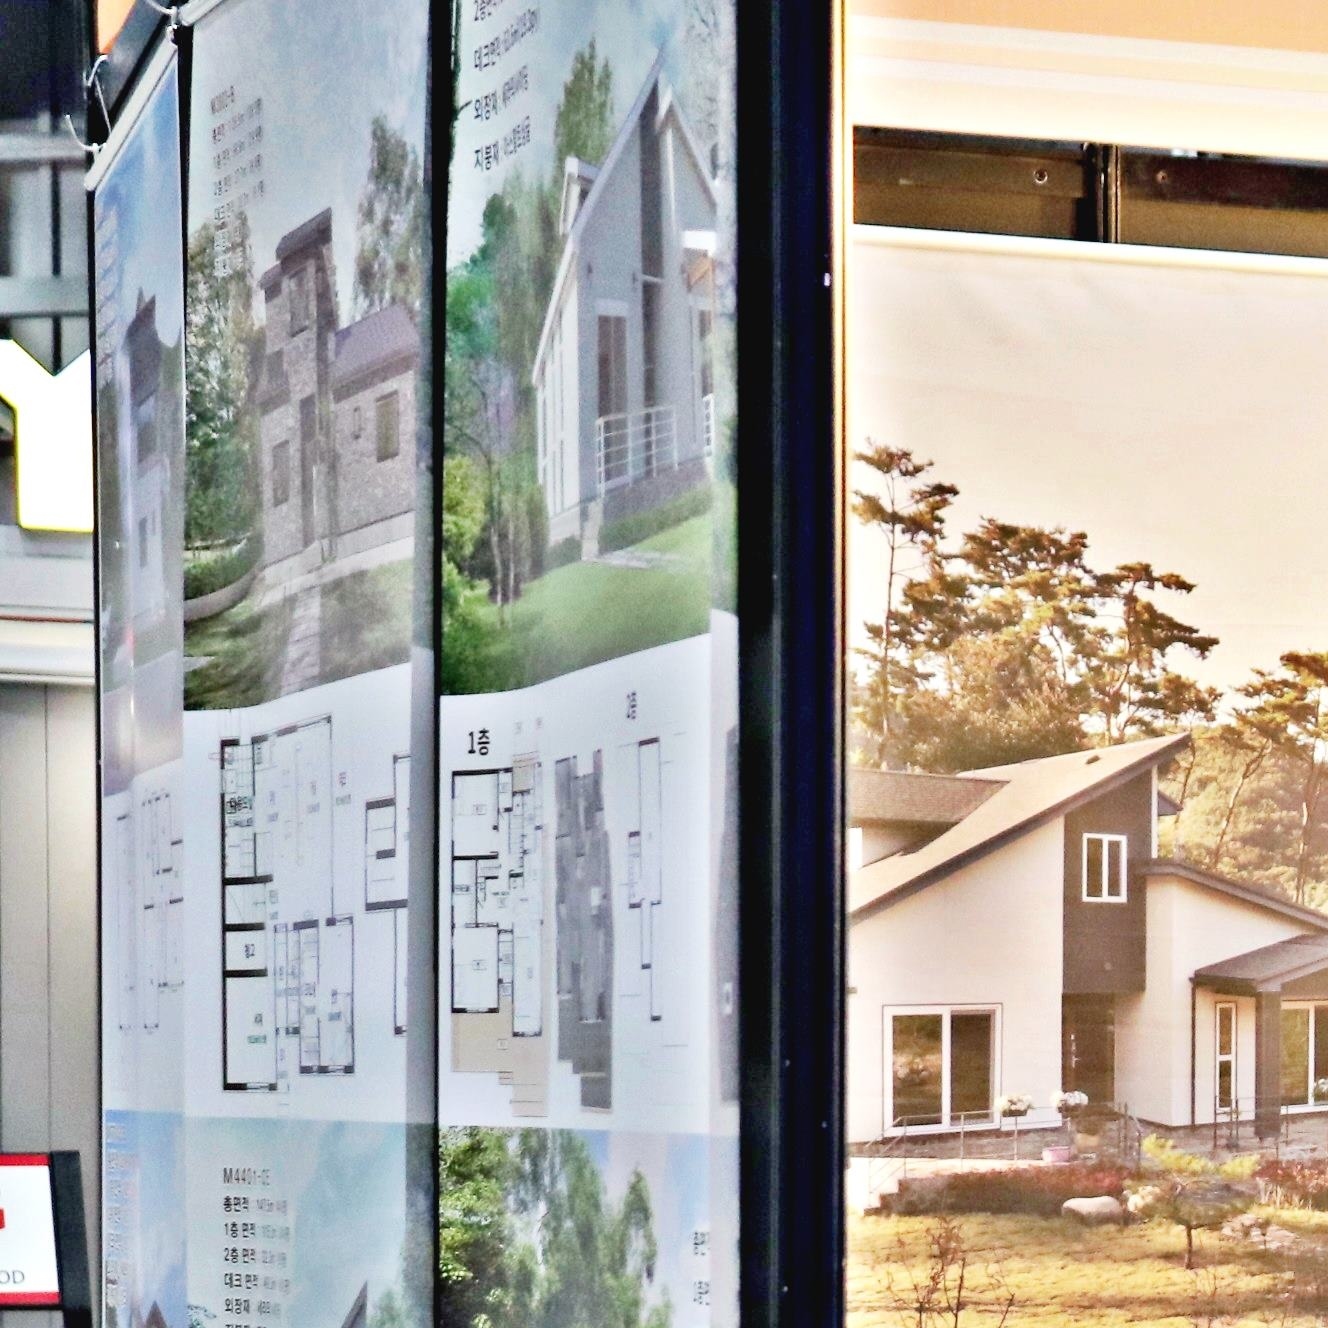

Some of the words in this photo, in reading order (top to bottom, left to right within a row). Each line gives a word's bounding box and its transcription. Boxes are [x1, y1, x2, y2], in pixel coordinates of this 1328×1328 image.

[467, 727, 490, 756] 1층
[224, 1221, 239, 1239] 1층
[224, 1247, 239, 1264] 2층
[224, 1272, 242, 1289] 데크
[224, 1297, 251, 1316] 외장재
